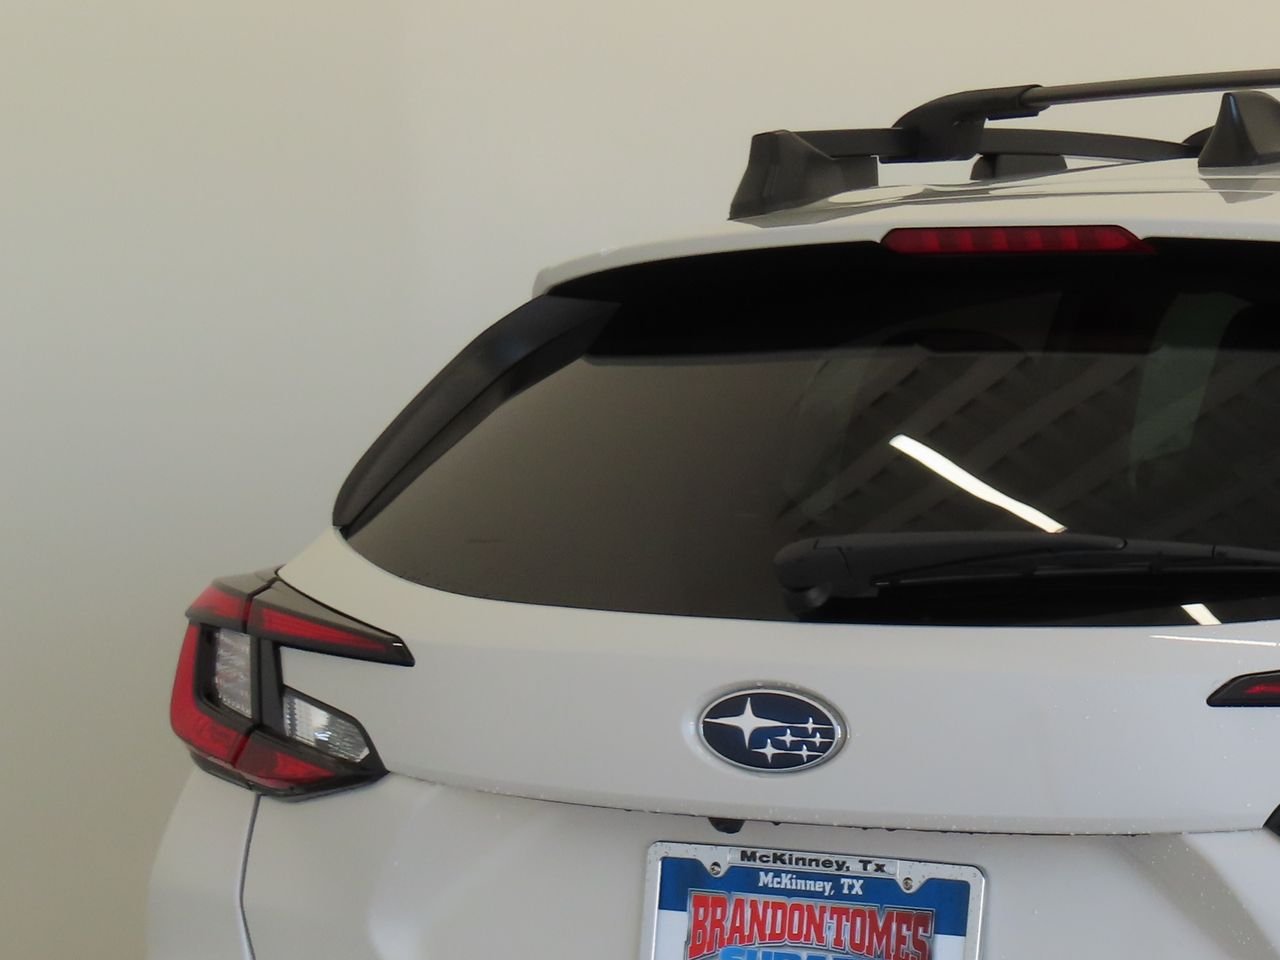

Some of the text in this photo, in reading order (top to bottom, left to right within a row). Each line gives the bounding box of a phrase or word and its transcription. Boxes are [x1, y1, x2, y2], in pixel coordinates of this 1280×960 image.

[740, 850, 886, 873] McKinney, Tx
[758, 872, 864, 896] McKinney, TX
